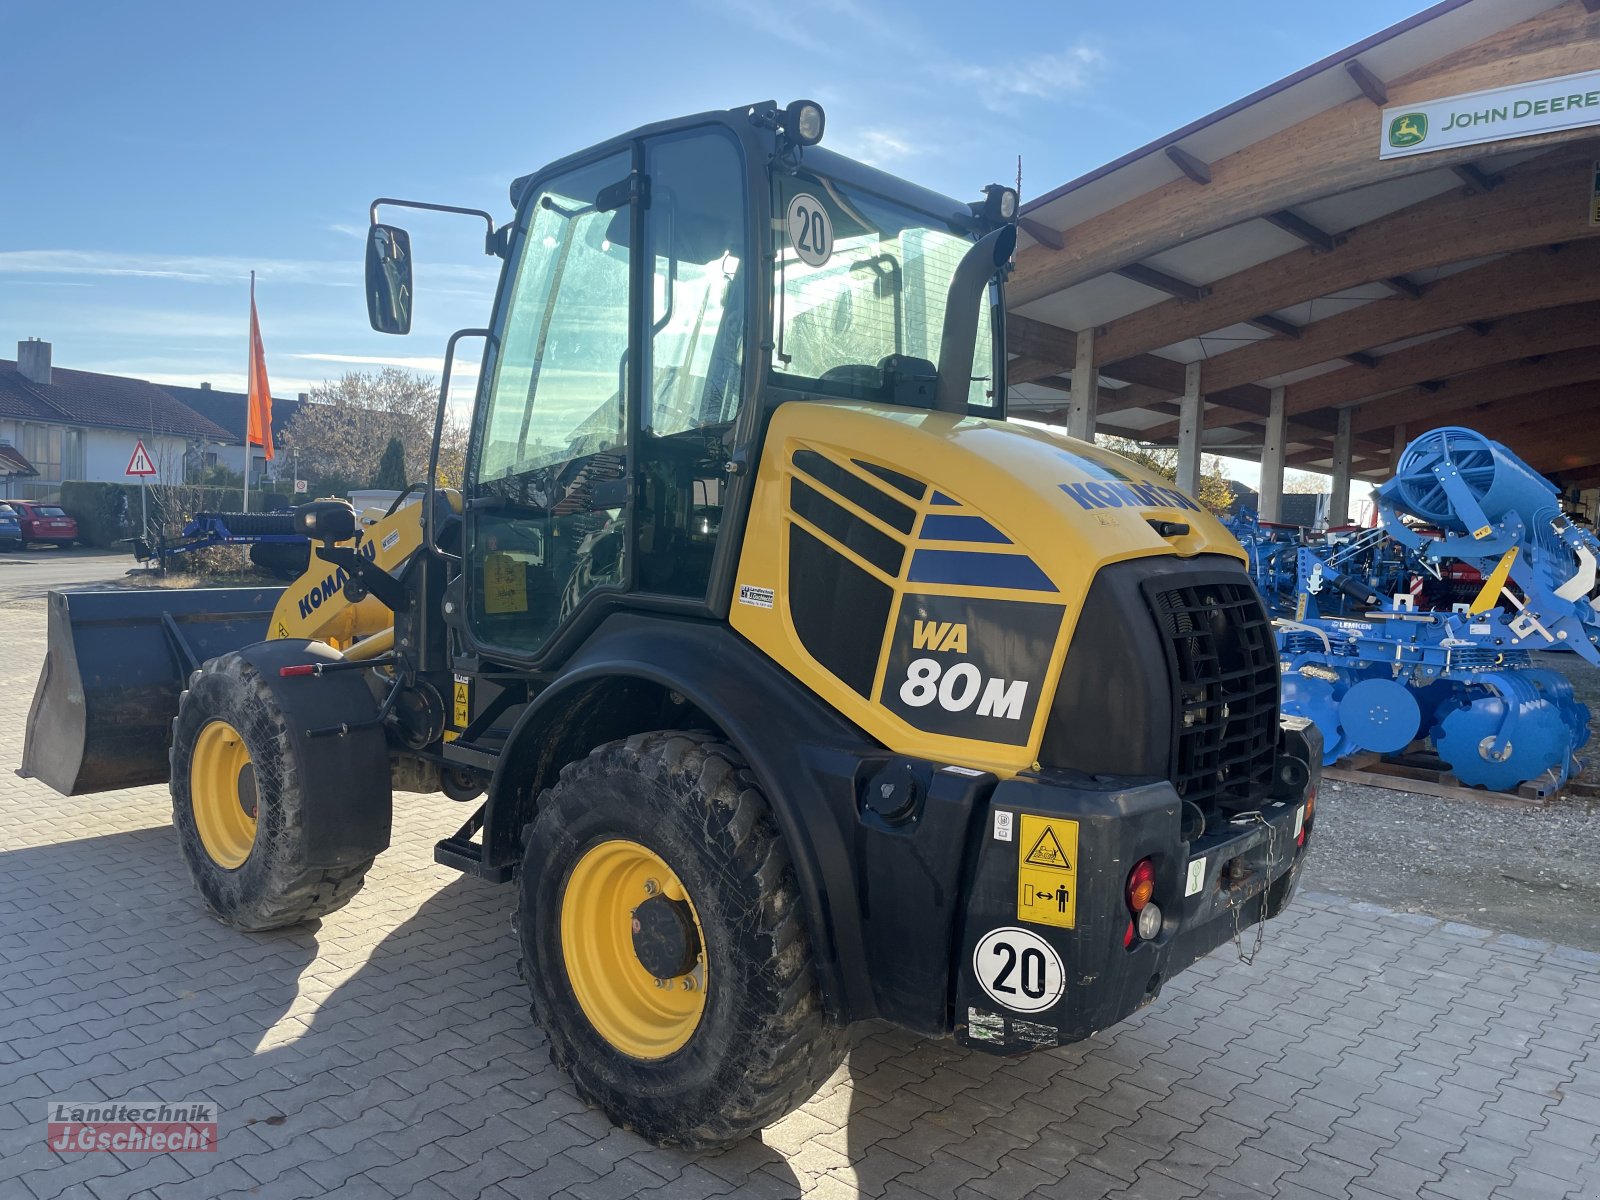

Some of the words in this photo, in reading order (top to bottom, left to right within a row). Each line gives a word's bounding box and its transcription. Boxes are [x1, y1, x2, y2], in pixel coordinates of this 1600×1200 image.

[1441, 107, 1507, 132] JOHN
[1513, 91, 1600, 119] DEERE
[797, 205, 826, 256] 20
[1057, 480, 1202, 512] KOMATSU
[298, 539, 376, 620] KOMAU
[912, 619, 968, 654] WA
[1339, 621, 1372, 630] LEMKEN
[992, 941, 1046, 999] 20
